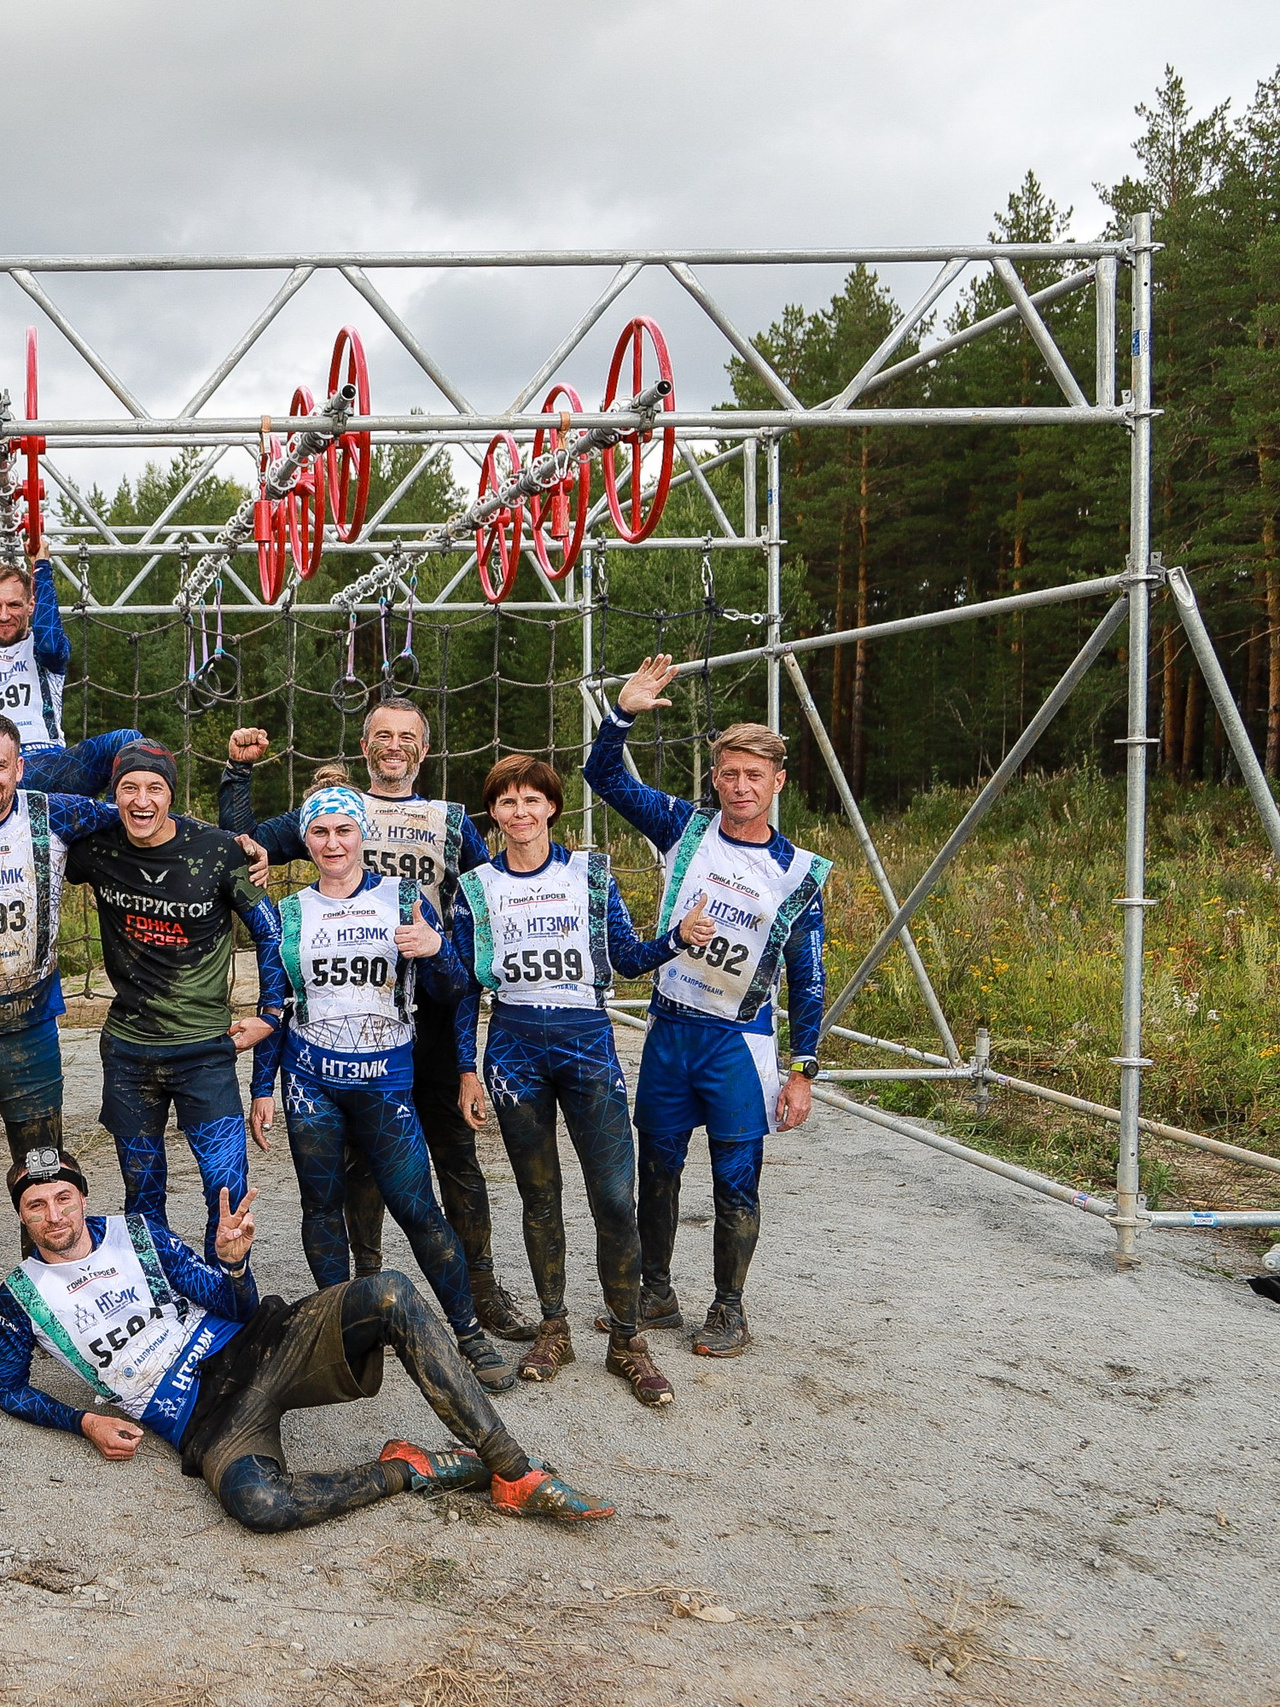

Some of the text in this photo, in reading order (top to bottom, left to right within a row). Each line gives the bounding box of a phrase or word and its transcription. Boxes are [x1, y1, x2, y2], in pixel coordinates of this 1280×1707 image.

[387, 825, 437, 846] НТЗМК
[363, 849, 436, 886] 5598
[708, 872, 760, 898] ГОНКА ГЕРОЕВ
[99, 886, 213, 919] ИНСТРУКТОР
[508, 893, 567, 905] ГОНКА ГЕРОЕВ
[126, 914, 184, 935] ГОНКА
[322, 911, 346, 919] ГОНКА
[527, 916, 580, 933] НТЗМК
[708, 899, 762, 933] НТЗМК
[125, 926, 190, 947] ГЕРОЕВ
[337, 927, 389, 942] НТЗМК
[502, 948, 583, 983] 5599
[686, 936, 750, 977] 92
[311, 956, 388, 987] 5590
[680, 974, 725, 997] ГАЗПРОМБАНК
[321, 1057, 390, 1079] НТЗМК
[66, 1267, 117, 1292] ГОНКА ГЕРОЕВ
